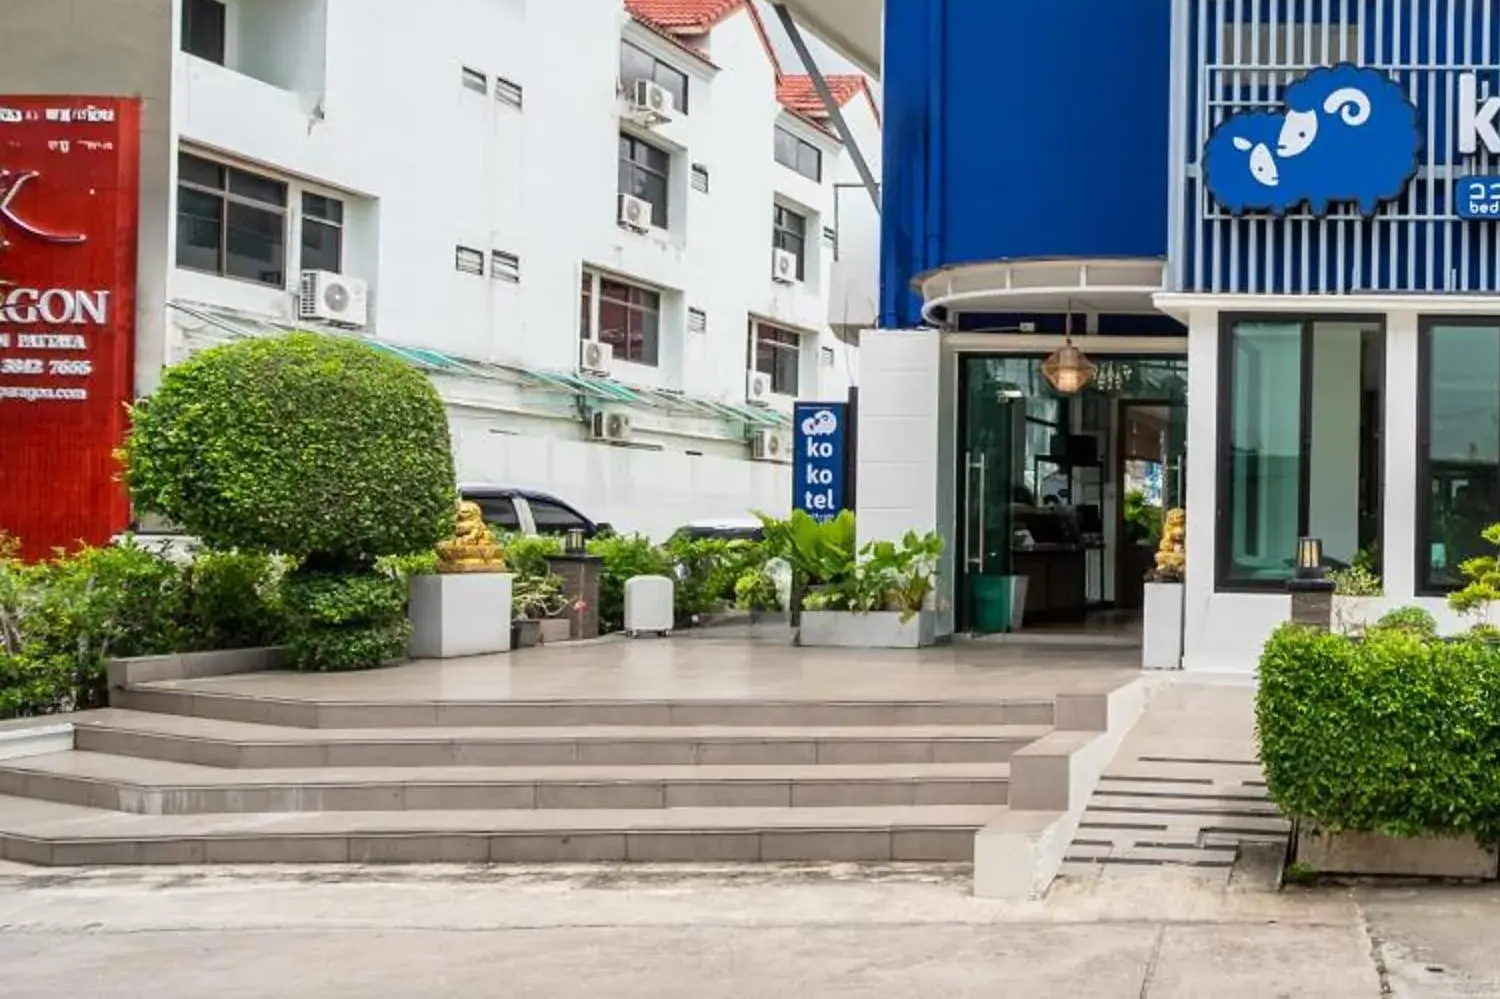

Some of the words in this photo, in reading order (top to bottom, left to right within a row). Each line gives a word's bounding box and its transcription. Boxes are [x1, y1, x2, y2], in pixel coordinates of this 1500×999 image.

[807, 436, 833, 458] ko
[807, 463, 833, 484] ko
[805, 489, 835, 510] tel
